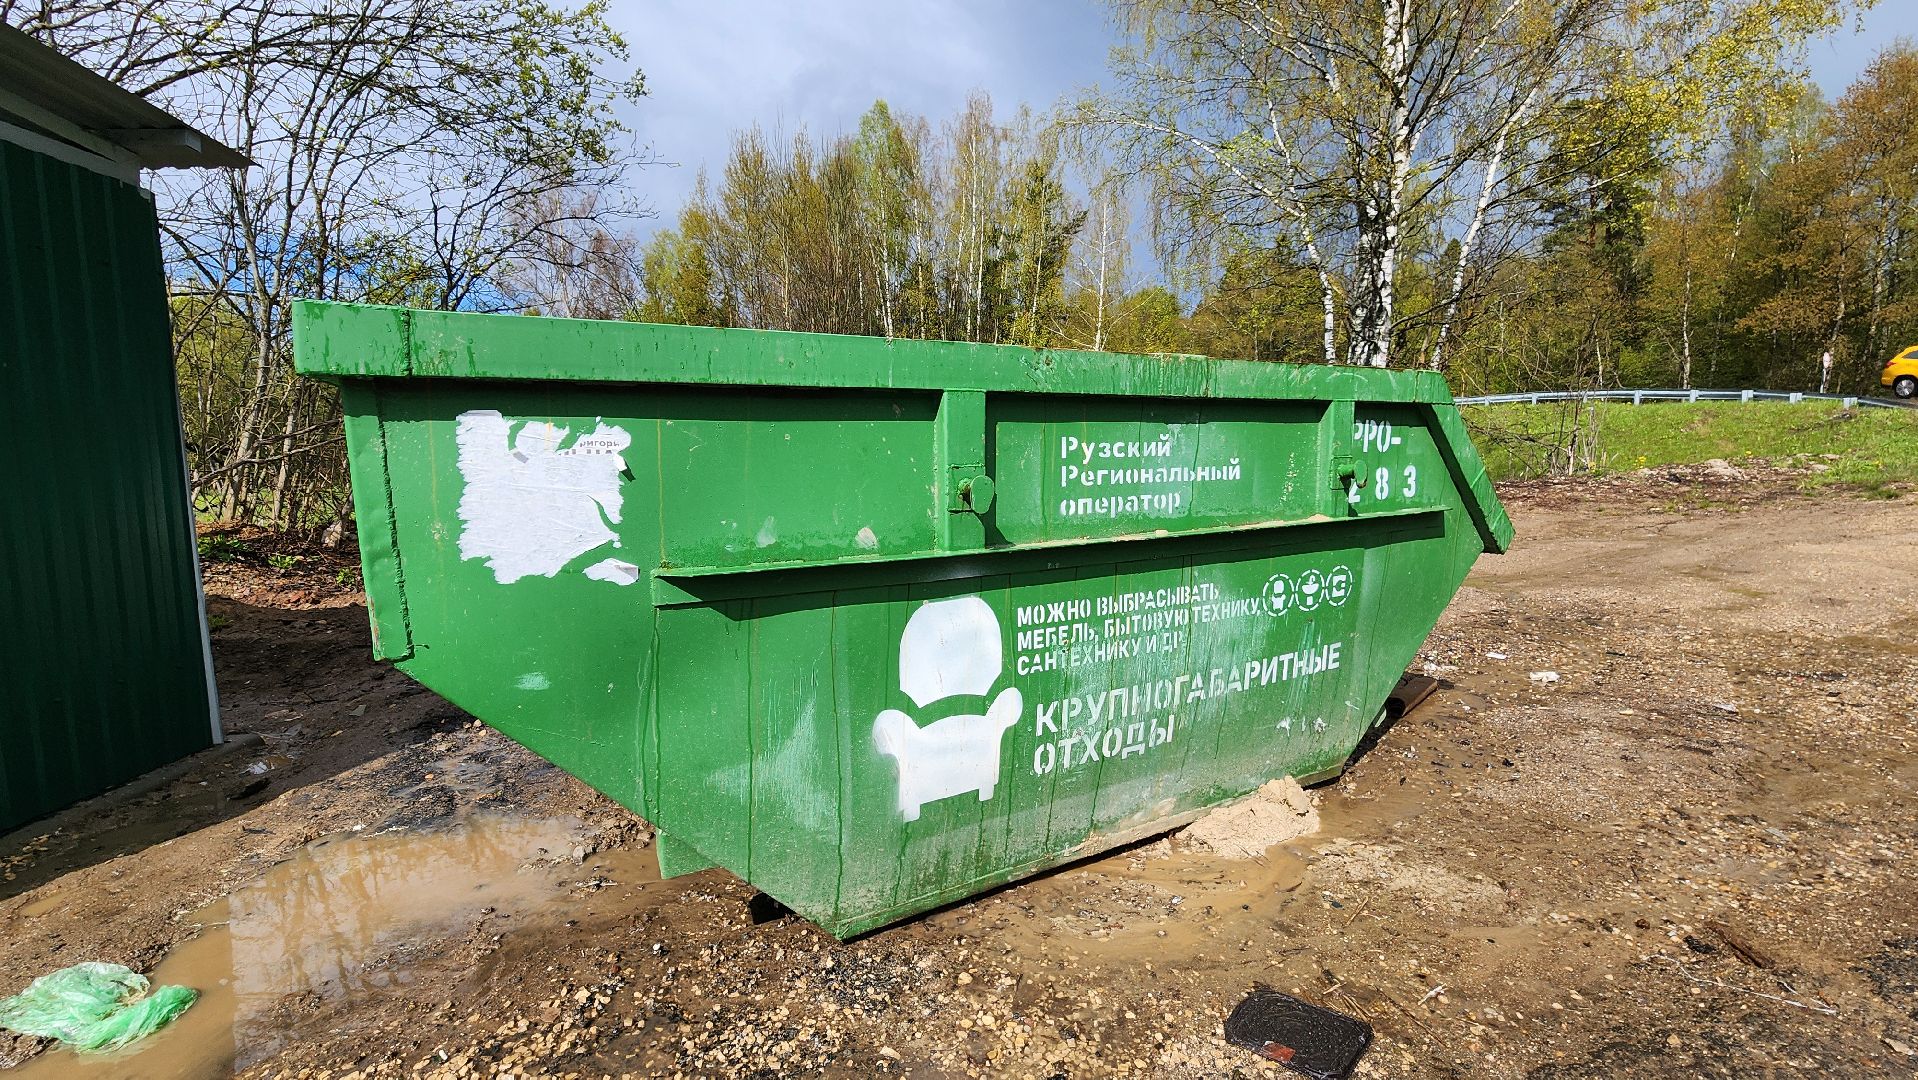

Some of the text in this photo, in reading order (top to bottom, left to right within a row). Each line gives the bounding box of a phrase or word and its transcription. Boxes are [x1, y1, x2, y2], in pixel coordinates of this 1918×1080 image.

[1061, 433, 1171, 465] Рузский
[1061, 457, 1241, 488] Региональный
[1060, 492, 1181, 518] оператор
[1017, 582, 1220, 627] МОЖНО ВЫБРАСЫВАТЬ
[1017, 597, 1261, 651] МЕБЕЛЬ, БЫТОВУЮ ТЕХНИКУ,
[1017, 638, 1141, 676] САНТЕХНИКУ
[1146, 634, 1158, 653] И
[1035, 642, 1342, 737] КРУПНОГАБАРИТНЫЕ
[1033, 715, 1175, 776] ОТХОДЫ
